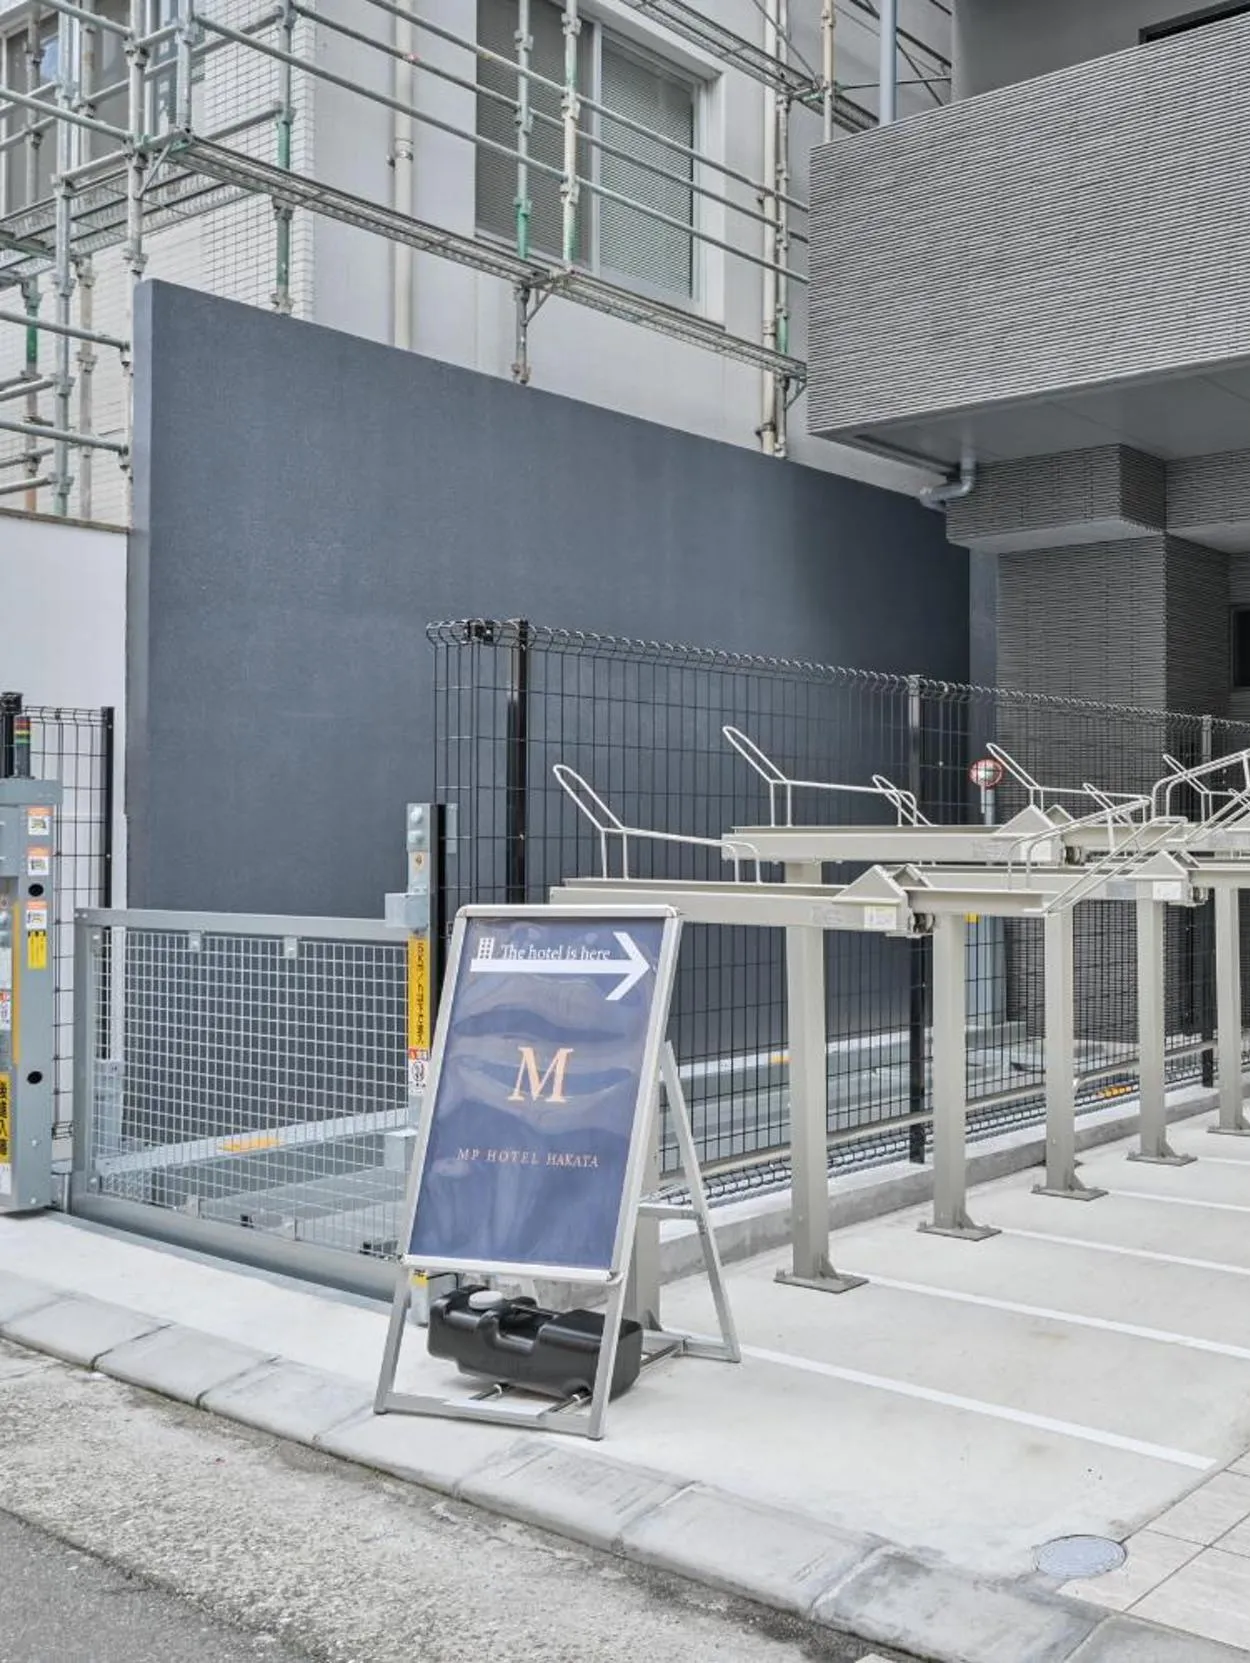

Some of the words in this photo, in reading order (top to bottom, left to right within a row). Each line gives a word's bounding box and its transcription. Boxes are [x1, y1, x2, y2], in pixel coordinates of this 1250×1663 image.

[501, 944, 525, 961] The
[528, 944, 563, 961] hotel
[566, 945, 577, 961] is
[580, 944, 611, 961] here
[507, 1045, 575, 1103] M
[456, 1148, 481, 1162] MP
[486, 1149, 540, 1165] HOTEL
[546, 1152, 600, 1169] HAKATA
